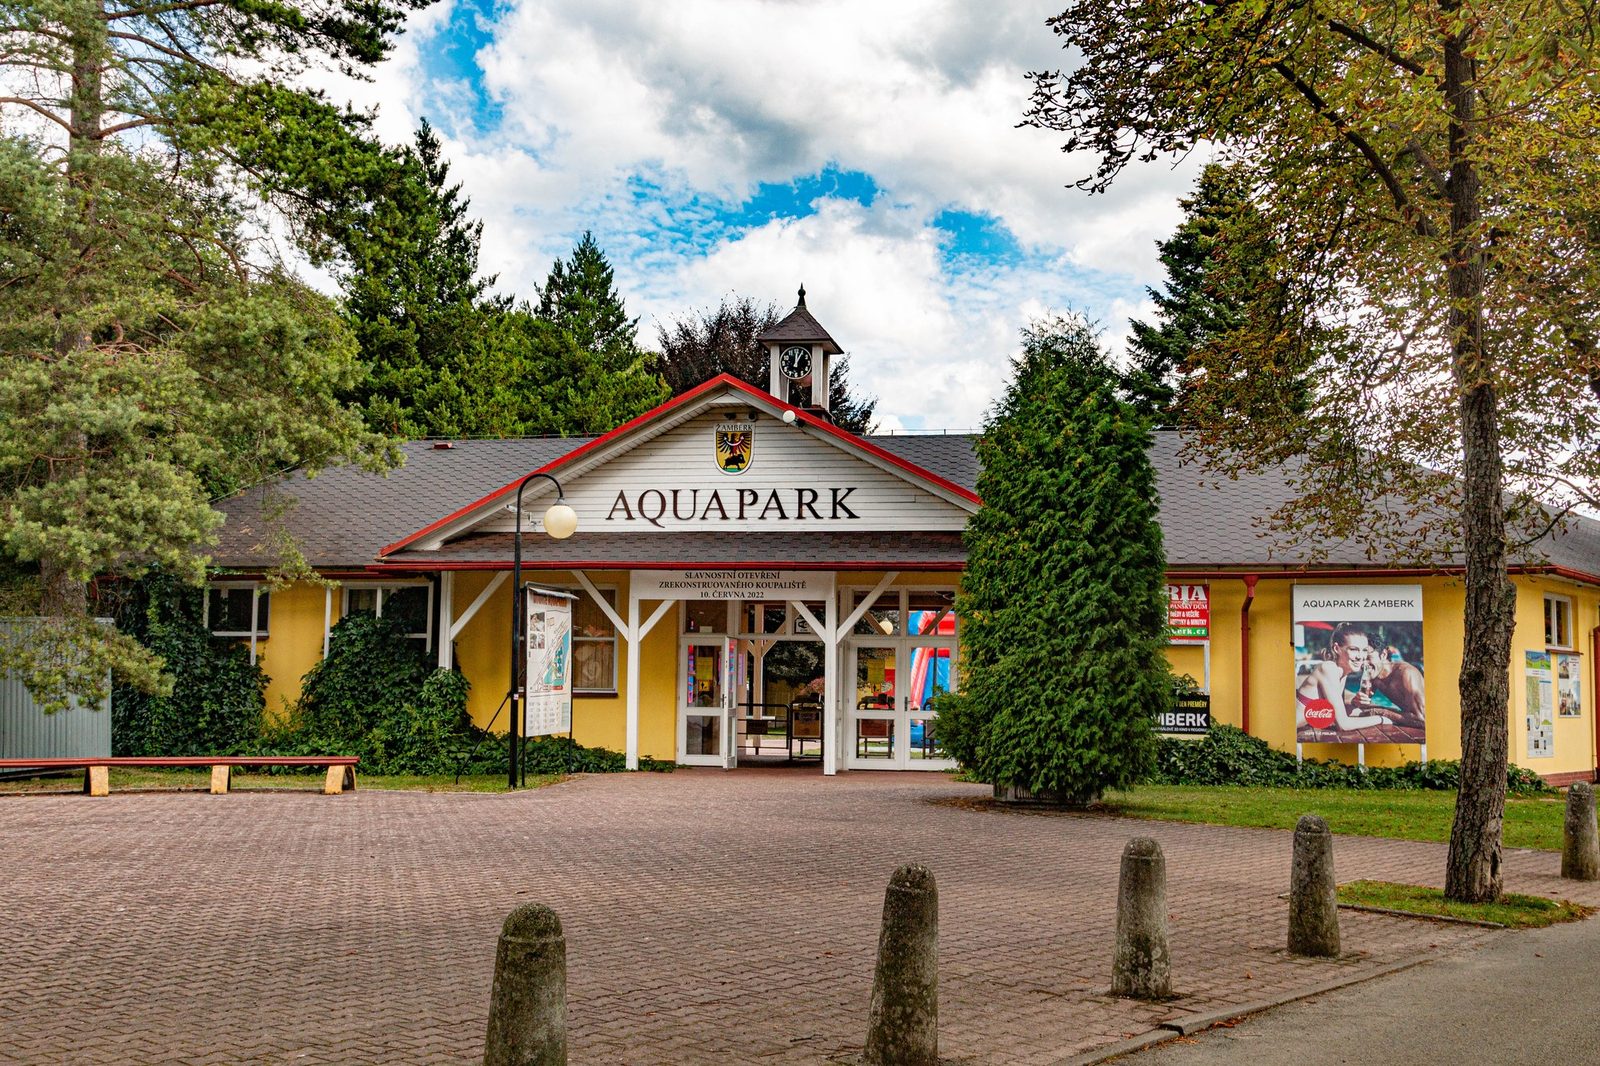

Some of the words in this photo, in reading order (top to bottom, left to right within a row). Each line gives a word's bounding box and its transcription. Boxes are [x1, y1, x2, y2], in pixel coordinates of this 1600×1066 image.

[605, 487, 861, 529] AQUAPARK
[684, 571, 737, 579] SLAVNOSTNÍ
[737, 571, 780, 579] OTEVŘENÍ
[659, 580, 754, 589] ZREKONSTRUOVANÉHO
[755, 580, 807, 589] KOUPALIŠTĚ
[1303, 599, 1361, 608] AQUAPARK
[1364, 598, 1414, 608] ŽAMBERK
[1305, 708, 1333, 719] Coca-Cola
